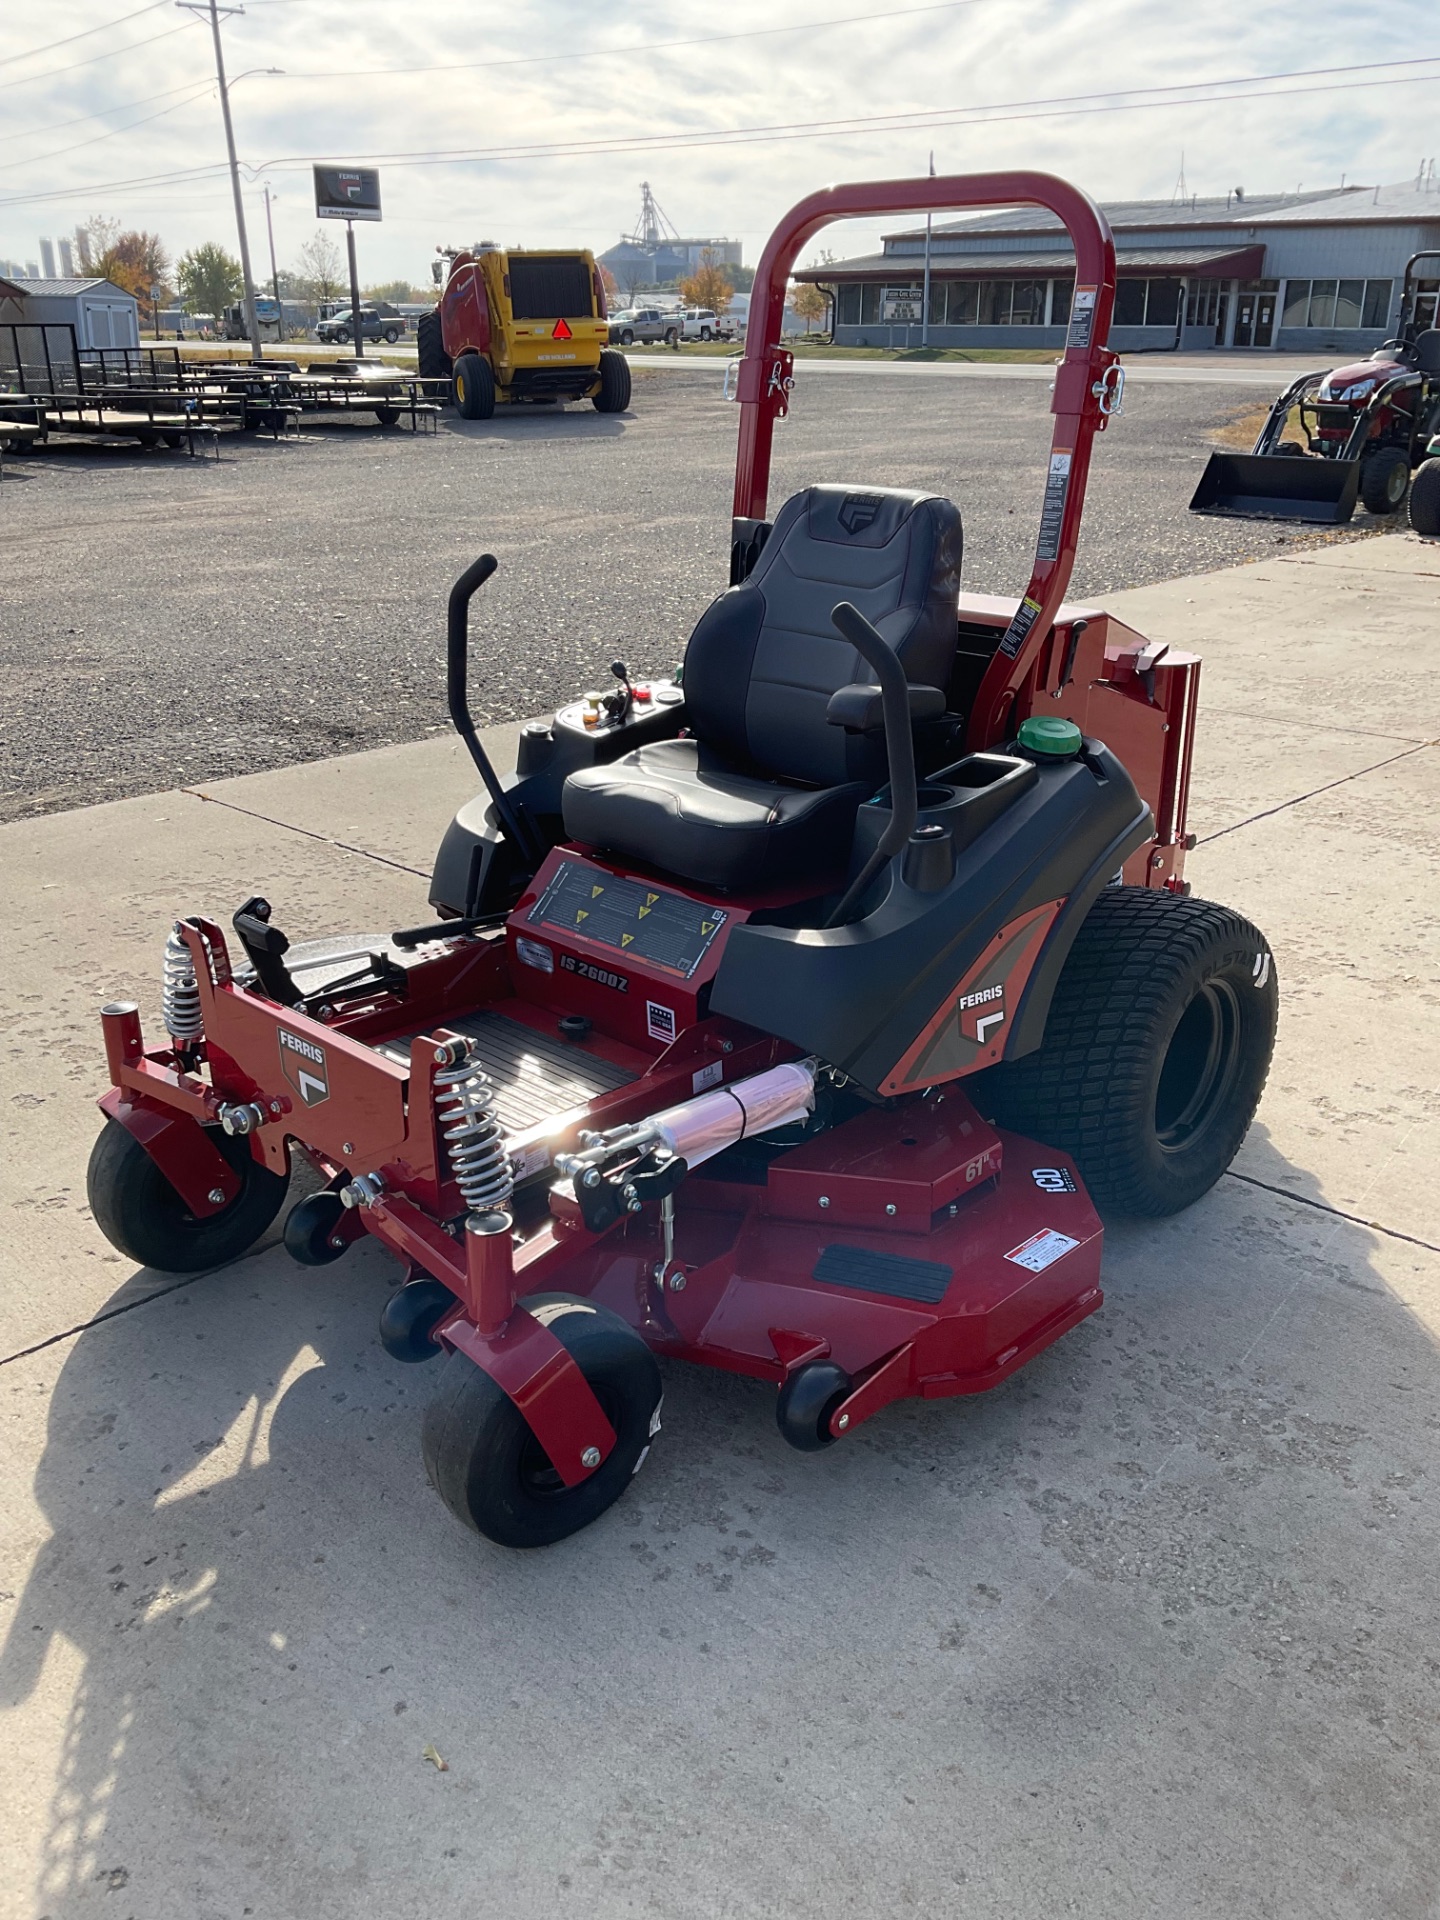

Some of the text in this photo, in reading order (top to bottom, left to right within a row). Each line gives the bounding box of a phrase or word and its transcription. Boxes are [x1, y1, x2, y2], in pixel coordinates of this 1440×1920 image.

[150, 292, 160, 300] 45
[847, 495, 881, 505] FERRIS
[578, 961, 629, 993] 2600Z
[960, 985, 1003, 1010] FERRIS
[280, 1030, 323, 1064] FERRIS
